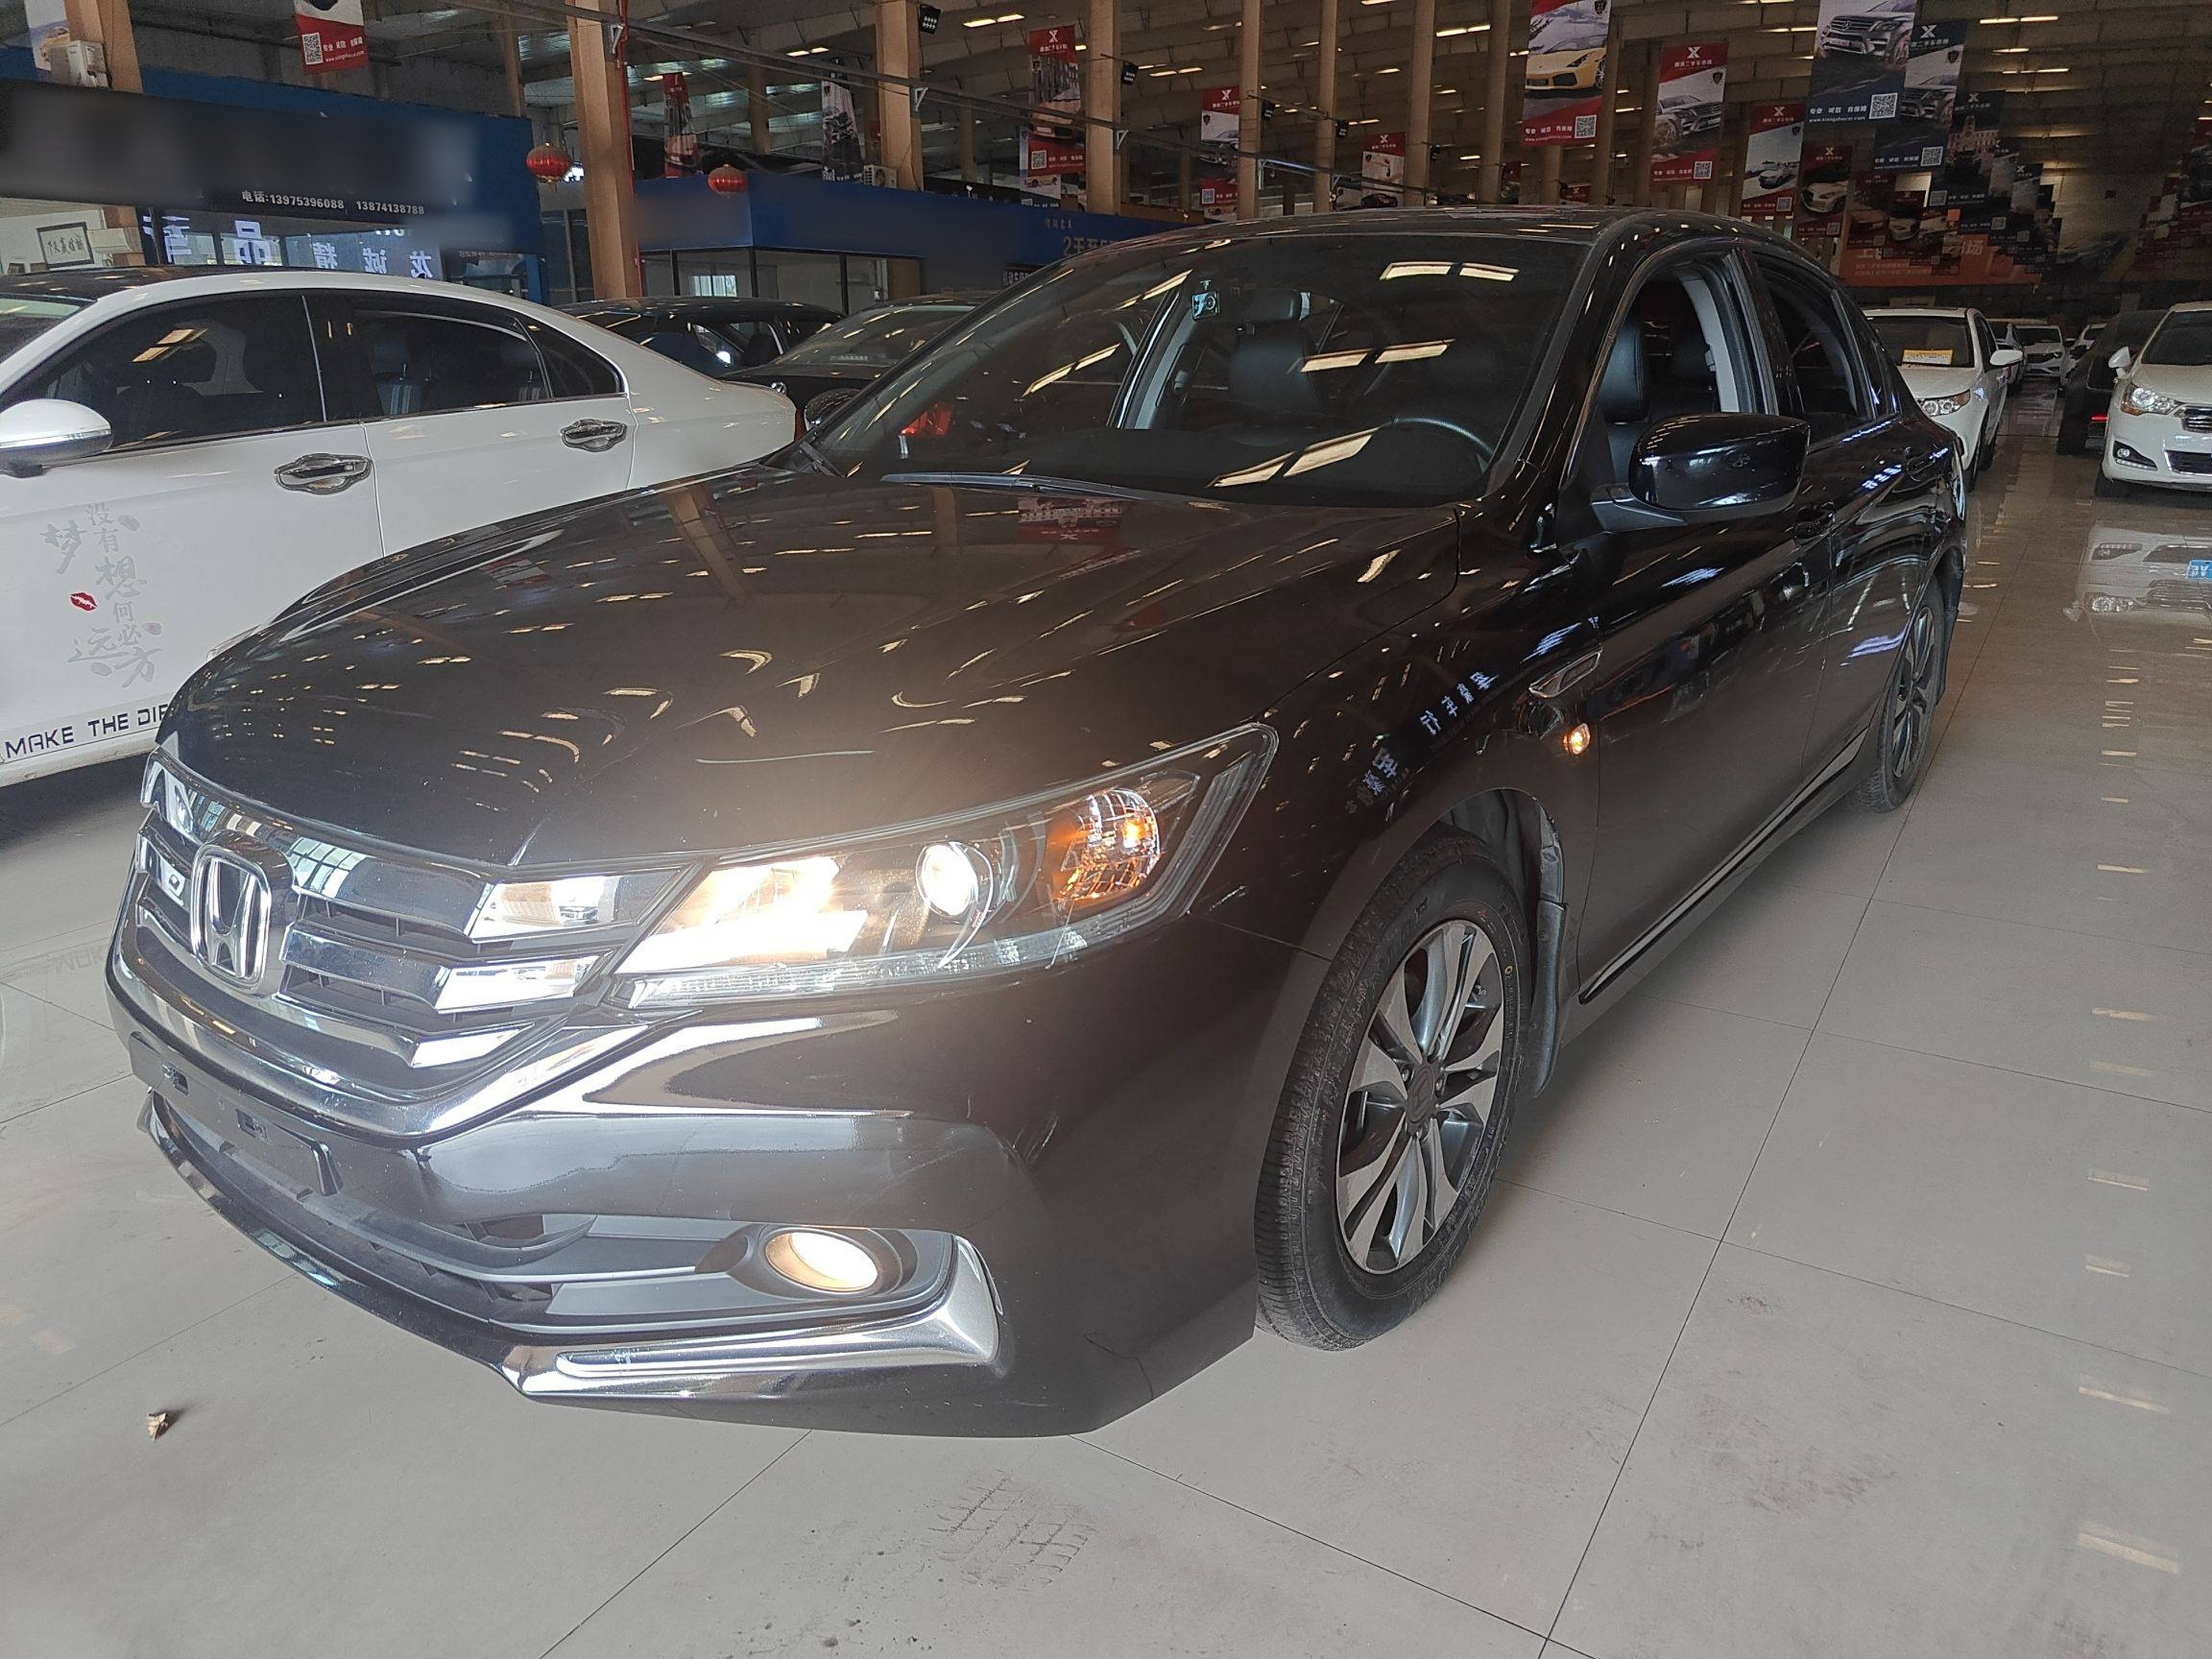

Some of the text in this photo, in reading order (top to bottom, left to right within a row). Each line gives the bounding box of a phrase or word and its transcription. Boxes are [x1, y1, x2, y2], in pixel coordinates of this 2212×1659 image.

[242, 190, 425, 215] 电话:13975396088 13874138788
[5, 726, 74, 759] MAKE
[88, 713, 129, 737] THE
